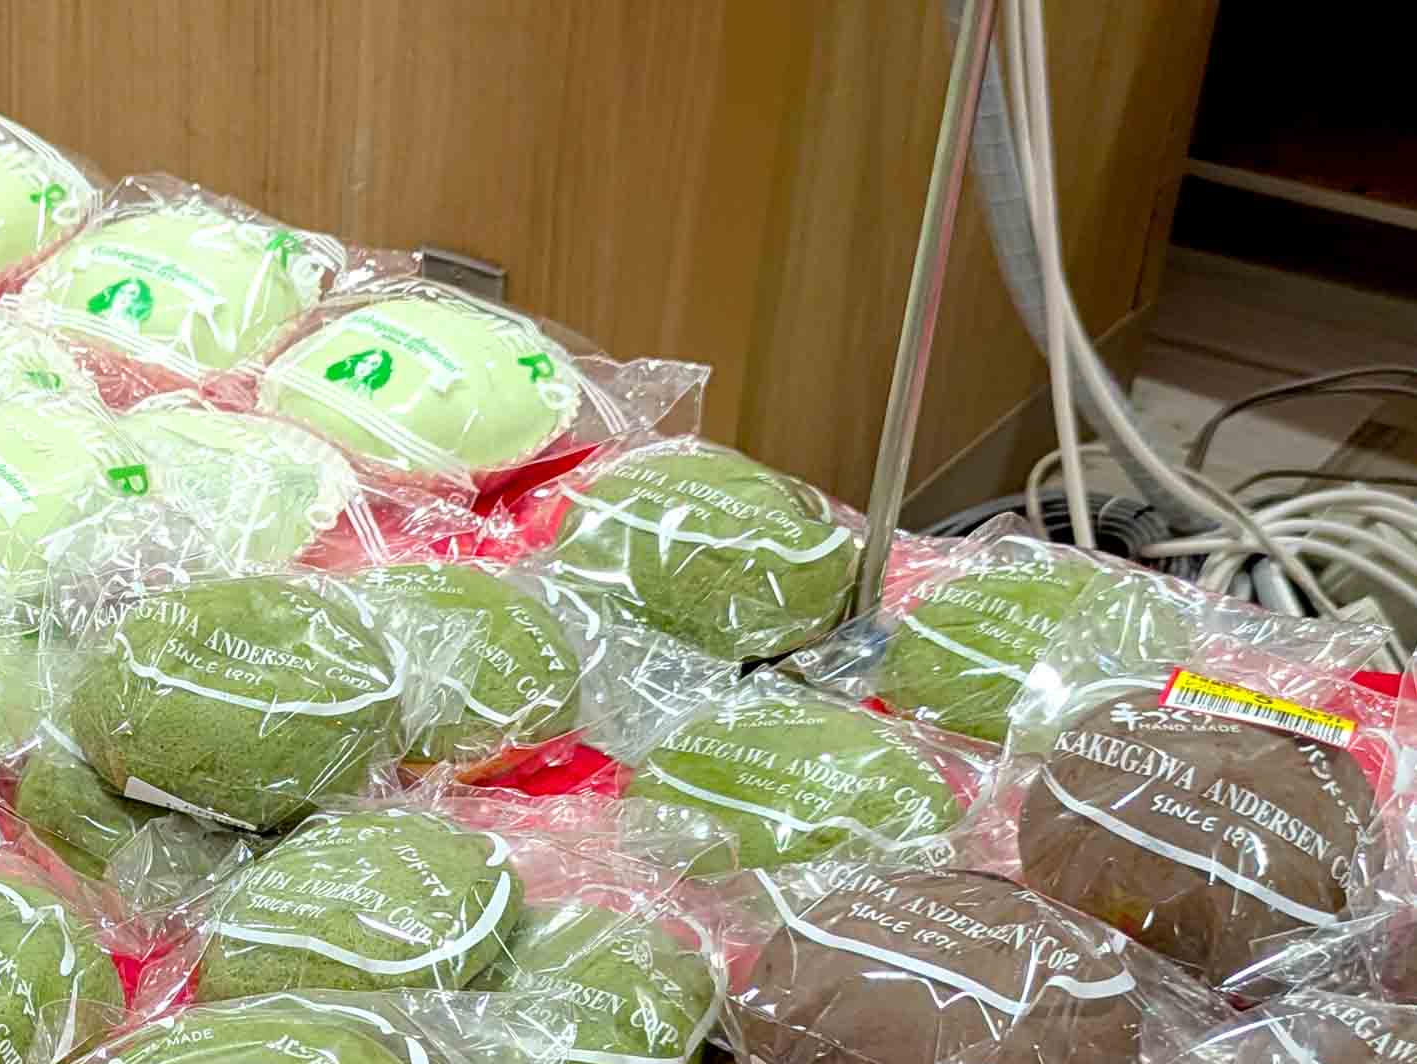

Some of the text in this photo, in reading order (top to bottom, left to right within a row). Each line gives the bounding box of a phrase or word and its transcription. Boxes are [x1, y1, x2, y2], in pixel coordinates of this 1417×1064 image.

[165, 637, 219, 676] SINCE
[203, 626, 319, 674] ANDERSEN
[661, 731, 778, 771] KAKEGAWA
[735, 770, 792, 794] SINCE
[1054, 730, 1199, 792] KAKEGAWA
[1202, 777, 1333, 861] ANDERSEN
[1150, 793, 1220, 832] SINCE
[851, 901, 908, 935] SINCE
[164, 1027, 215, 1049] MADE
